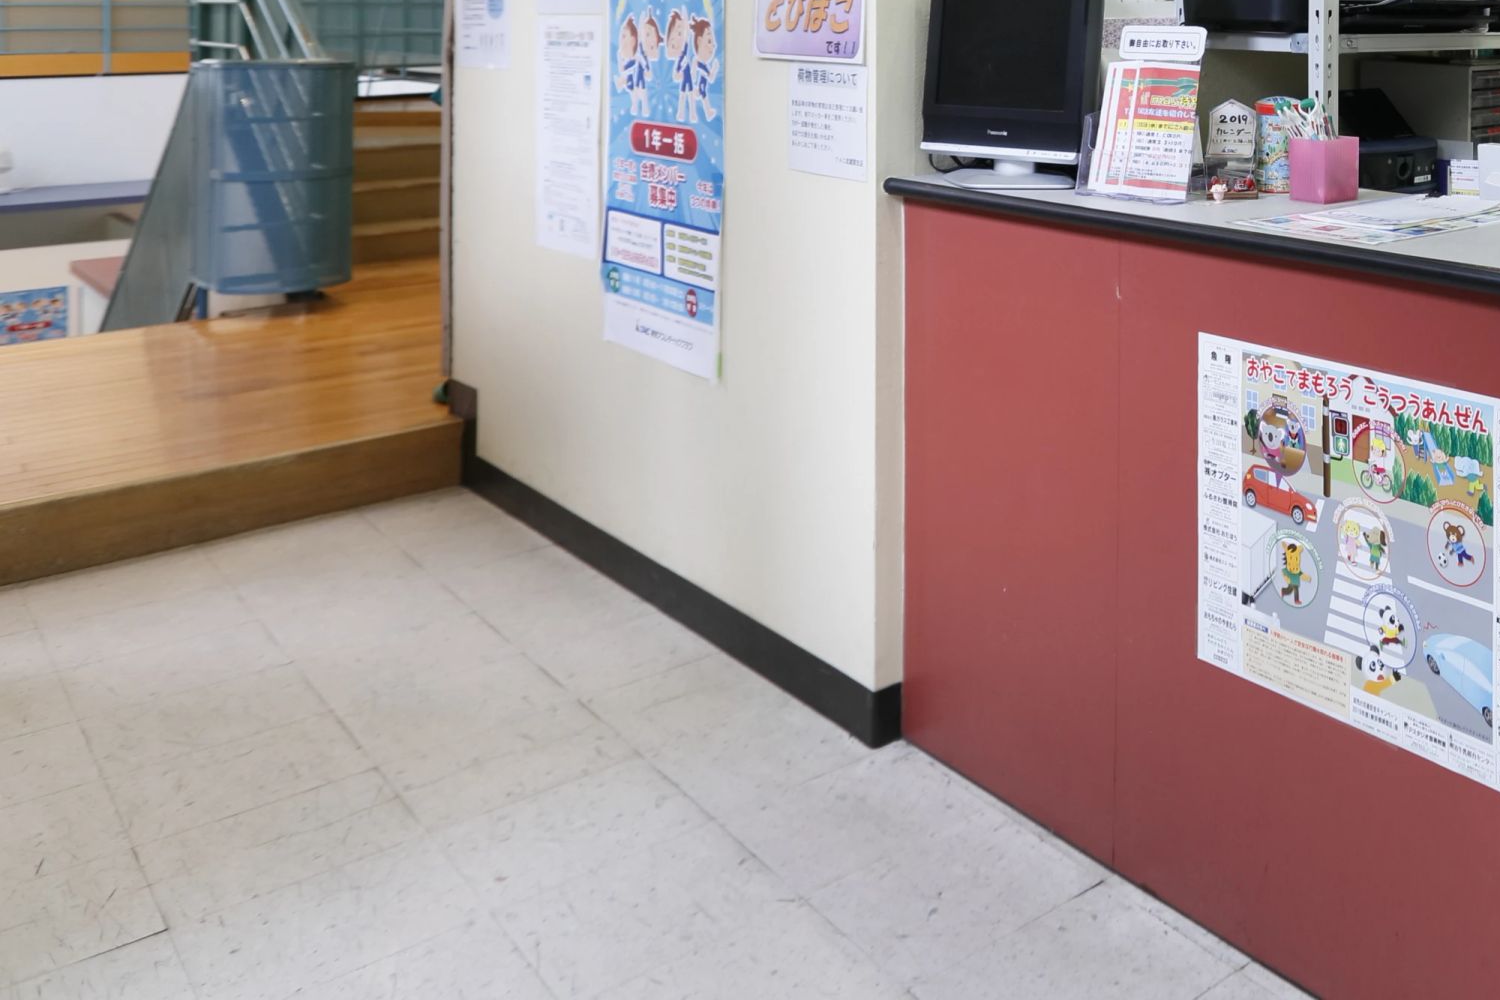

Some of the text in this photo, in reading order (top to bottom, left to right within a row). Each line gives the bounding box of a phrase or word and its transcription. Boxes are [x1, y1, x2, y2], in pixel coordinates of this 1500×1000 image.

[1219, 114, 1248, 125] 2019
[987, 129, 1008, 137] Panasonic
[1364, 385, 1487, 433] こうつうあんぜん
